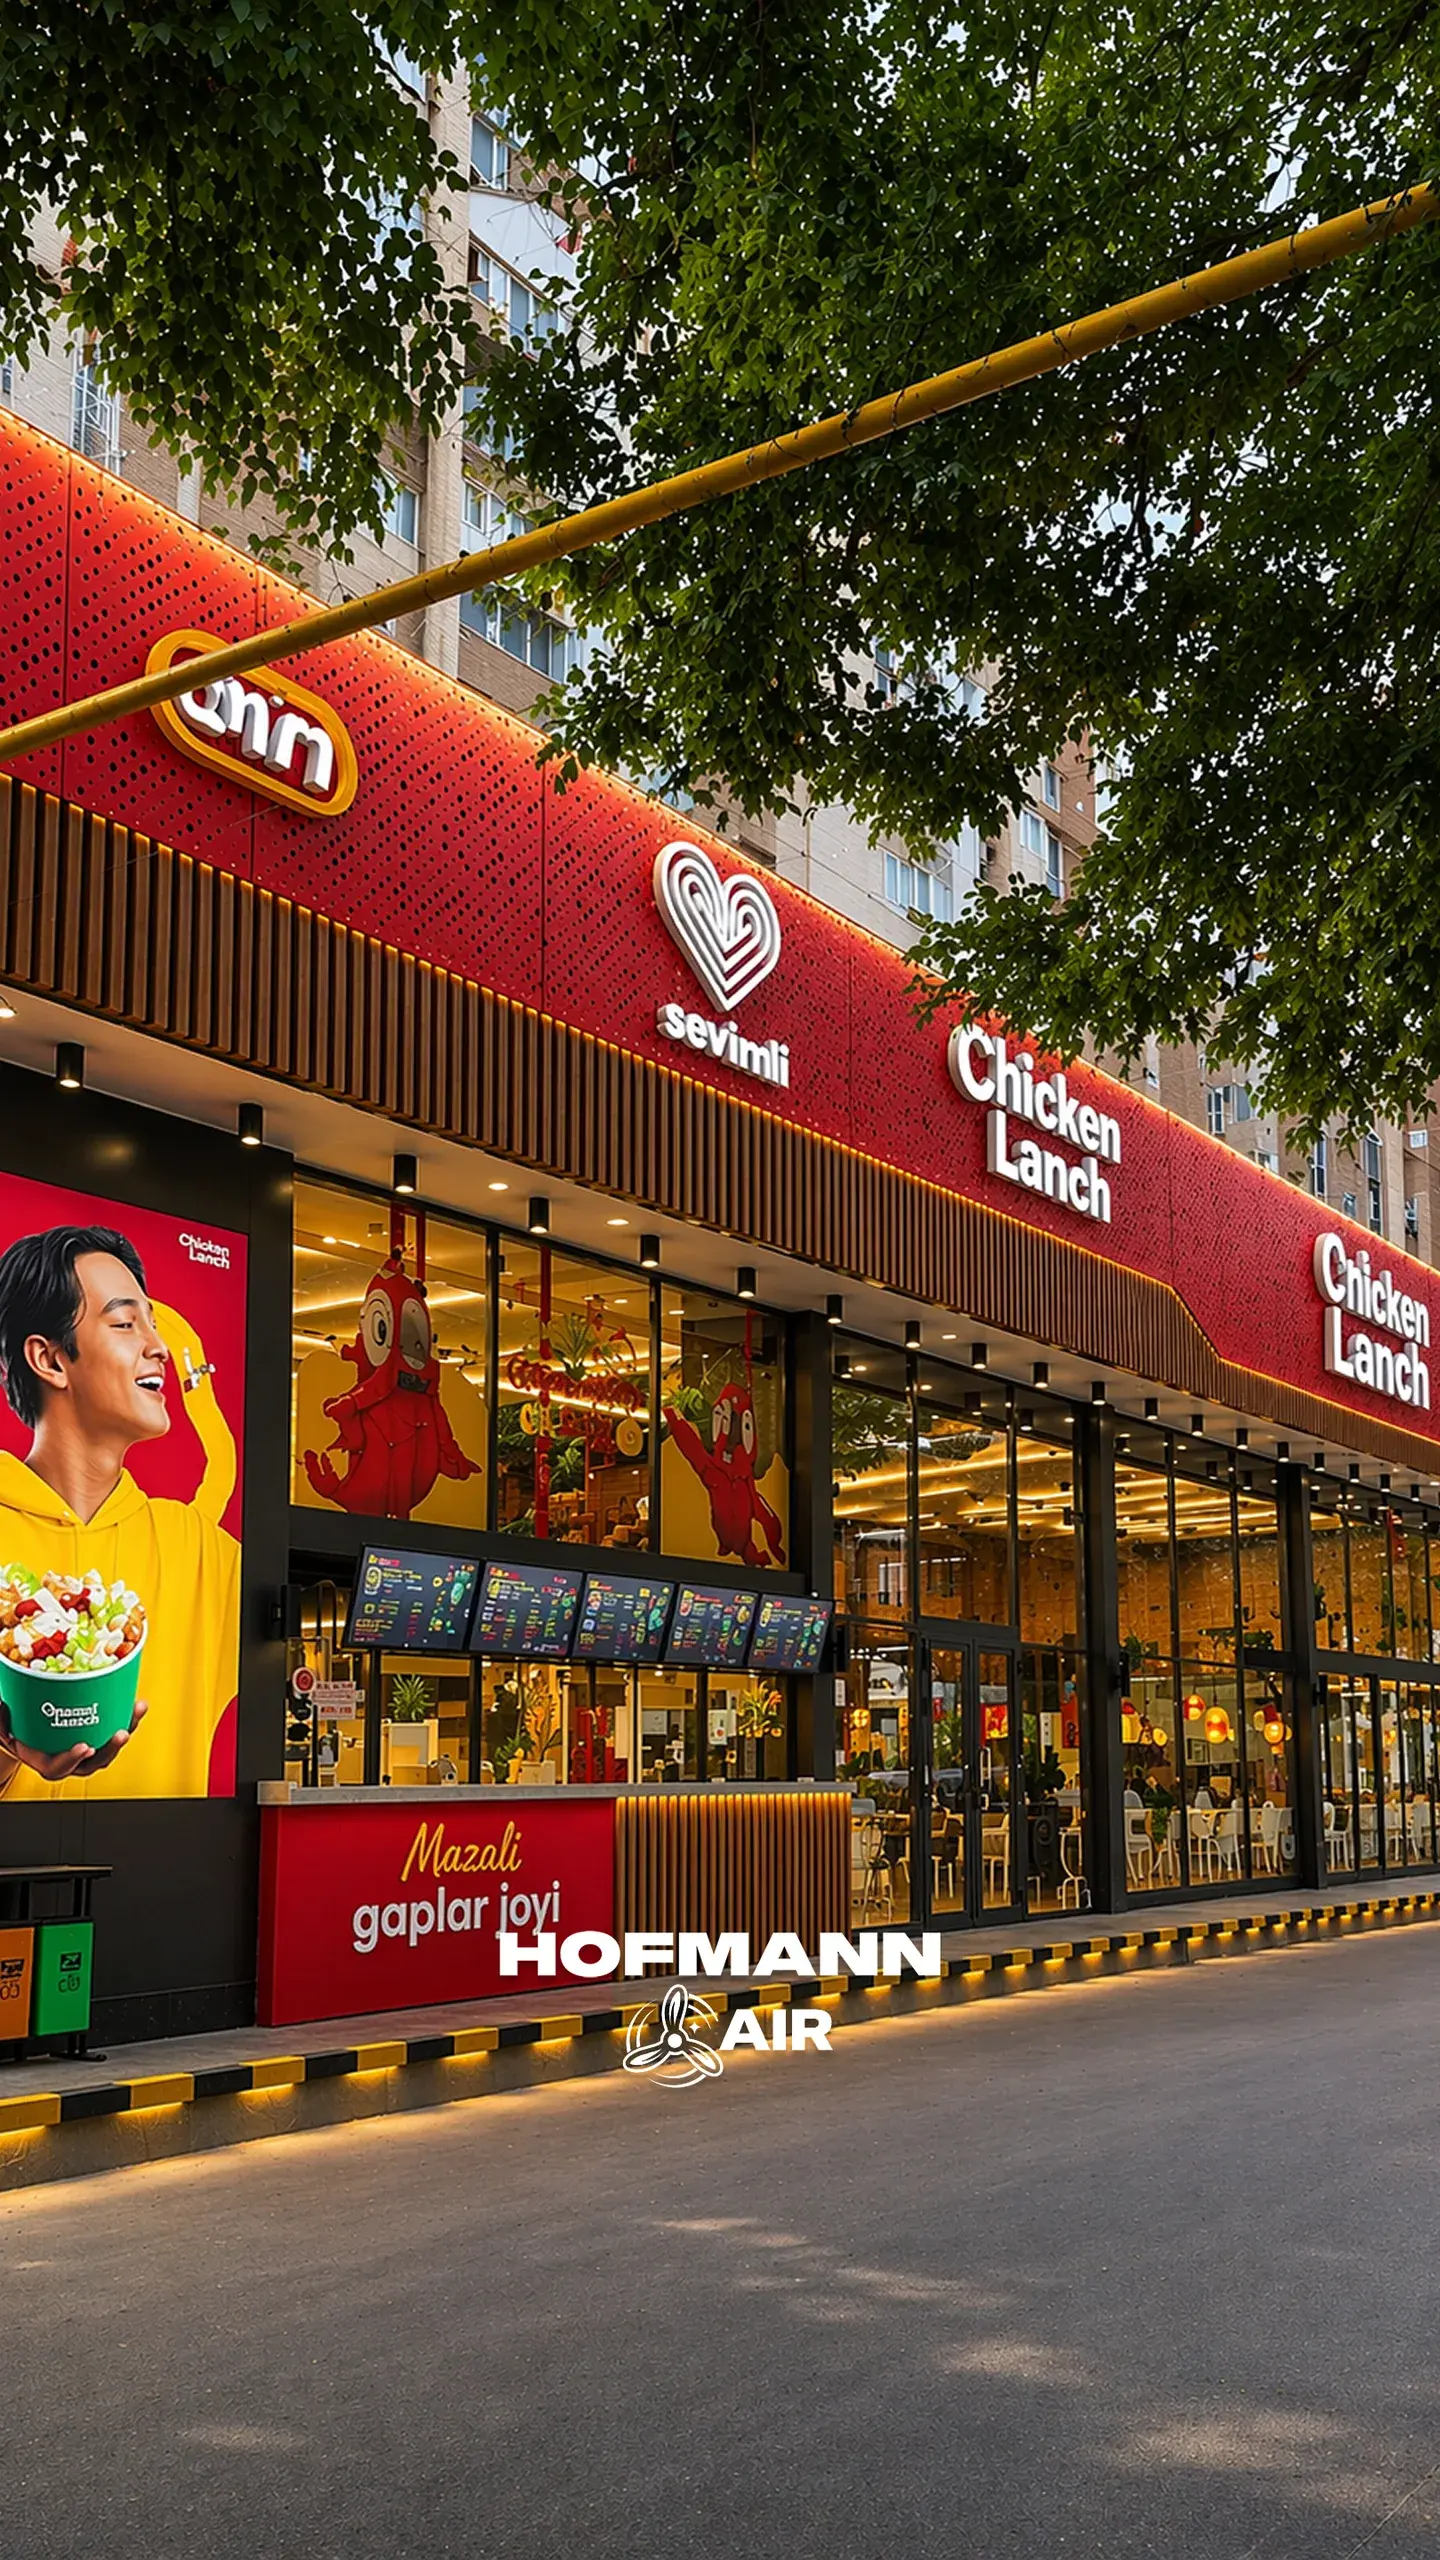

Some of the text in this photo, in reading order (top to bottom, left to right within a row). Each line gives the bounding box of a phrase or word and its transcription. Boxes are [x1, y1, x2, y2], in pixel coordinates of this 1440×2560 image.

[656, 1003, 790, 1089] sevimli
[948, 1023, 1121, 1164] Chicken
[986, 1109, 1112, 1224] Lanch
[1314, 1232, 1431, 1348] Chicken
[1324, 1305, 1431, 1411] Lanch
[400, 1820, 523, 1882] Mazali
[353, 1880, 560, 1953] gaplar joyi
